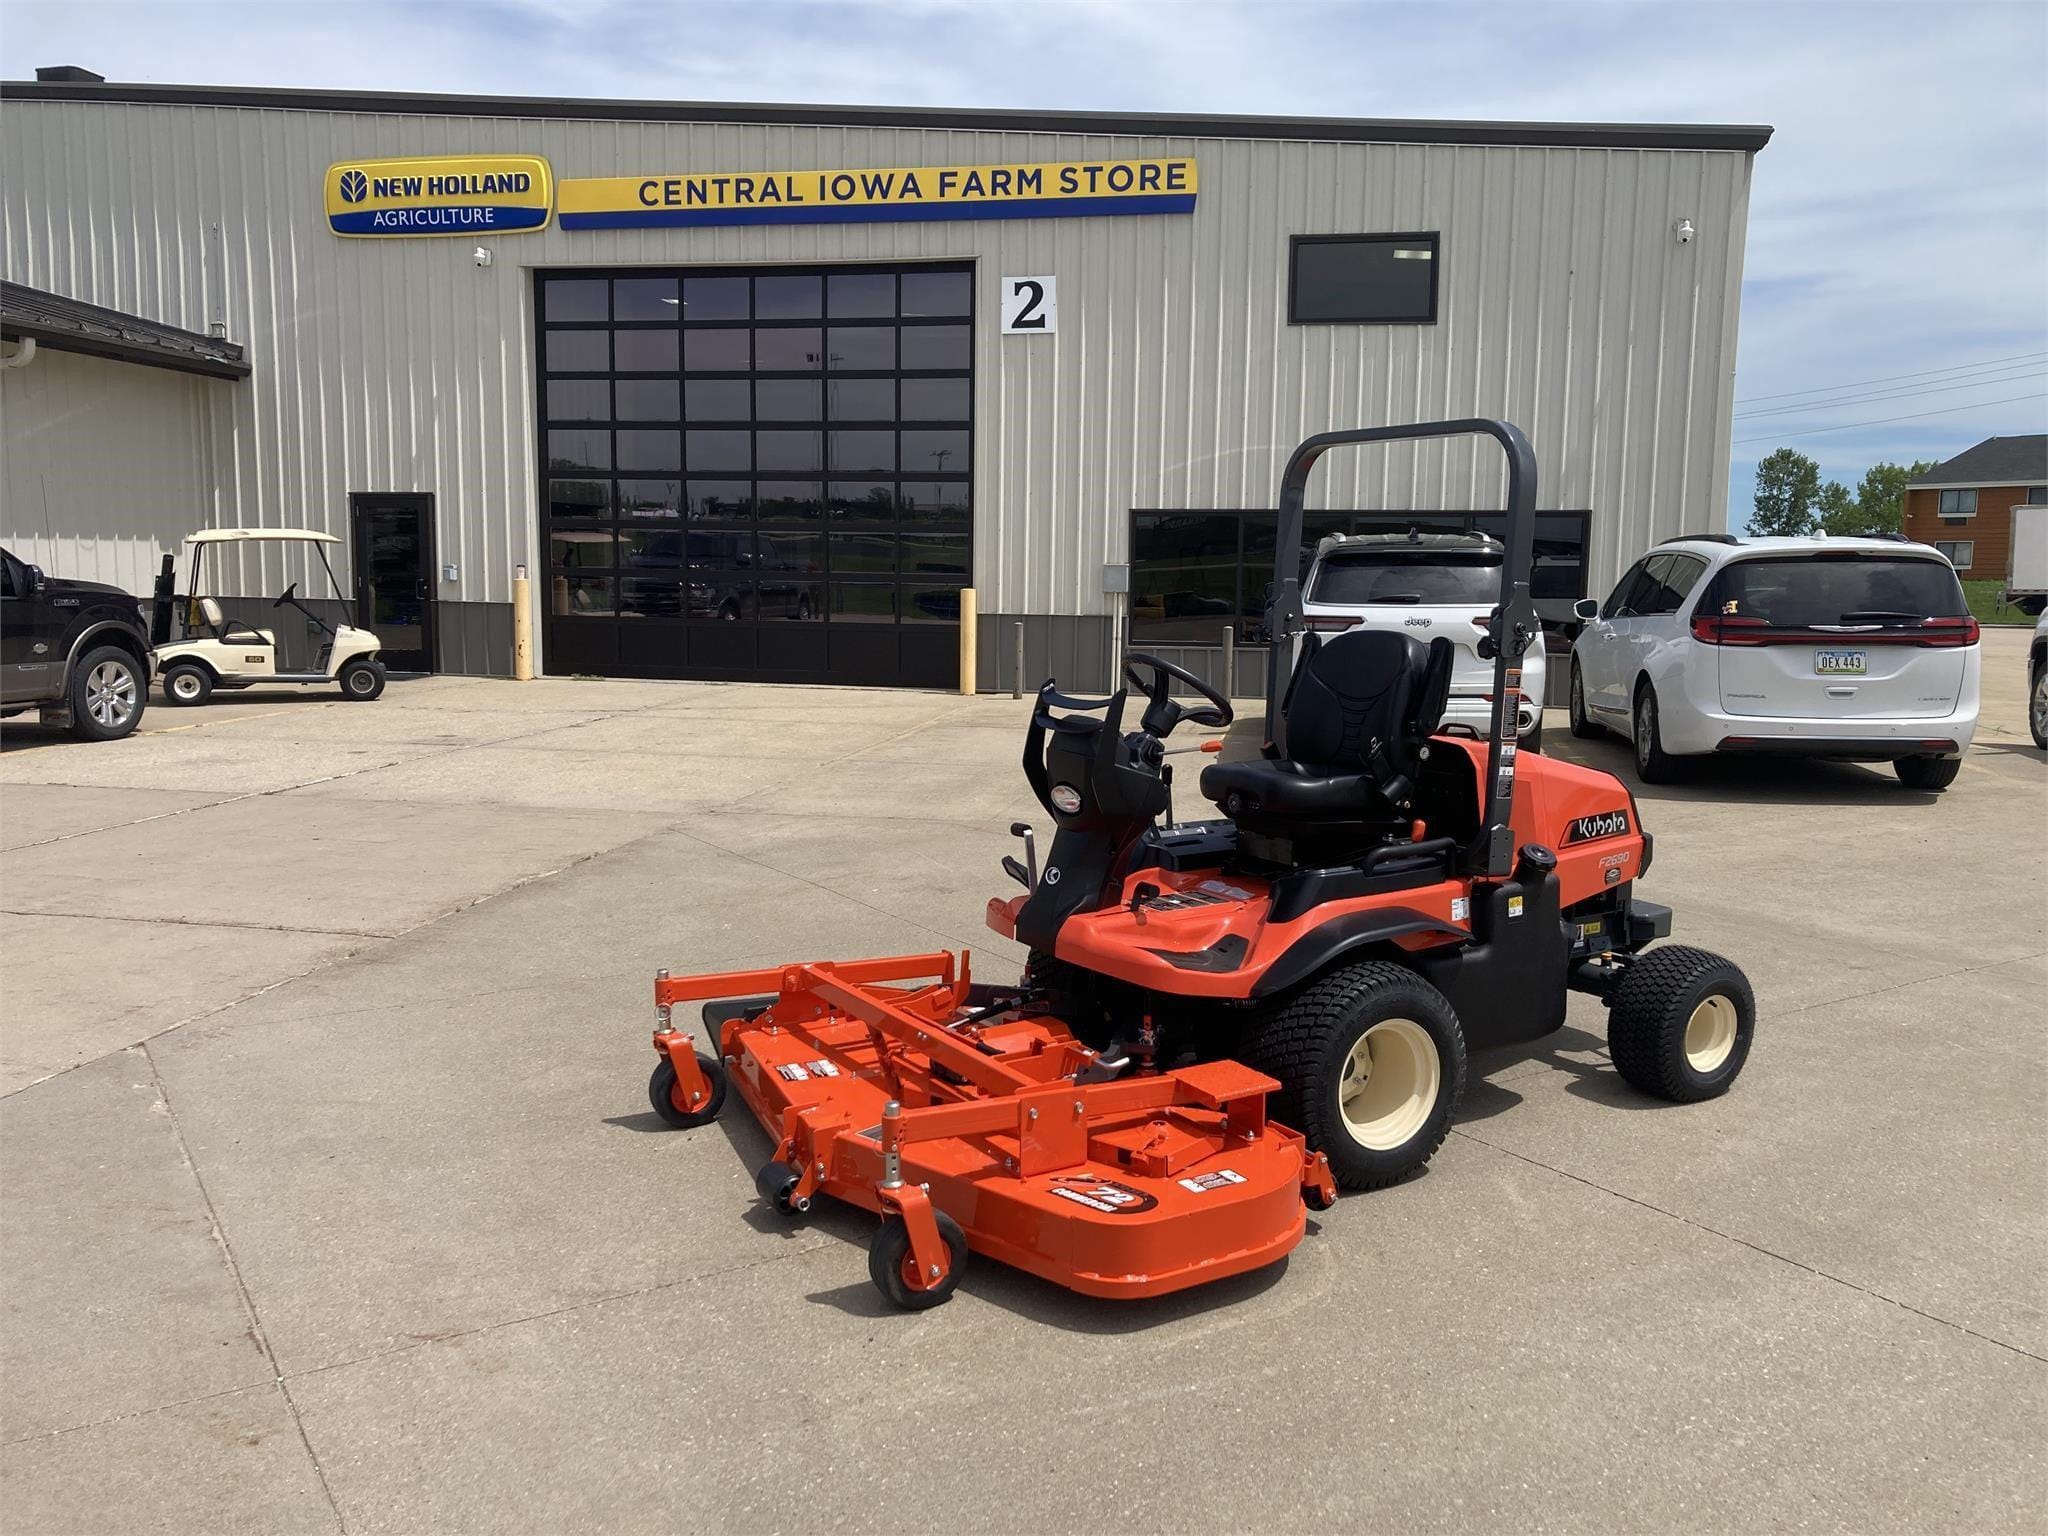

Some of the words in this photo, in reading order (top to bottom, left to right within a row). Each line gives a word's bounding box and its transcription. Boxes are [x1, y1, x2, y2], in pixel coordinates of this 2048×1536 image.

[373, 177, 423, 198] NEW
[428, 173, 530, 196] HOLLAND
[638, 175, 804, 207] CENTRAL
[819, 172, 923, 202] IOWA
[939, 168, 1043, 198] FARM
[1059, 162, 1187, 194] STORE
[373, 207, 494, 227] AGRICULTURE
[1011, 280, 1046, 329] 2
[1404, 615, 1432, 628] Jeep
[1843, 656, 1861, 669] 443
[1578, 812, 1626, 838] Kubota
[1599, 851, 1631, 868] F2690
